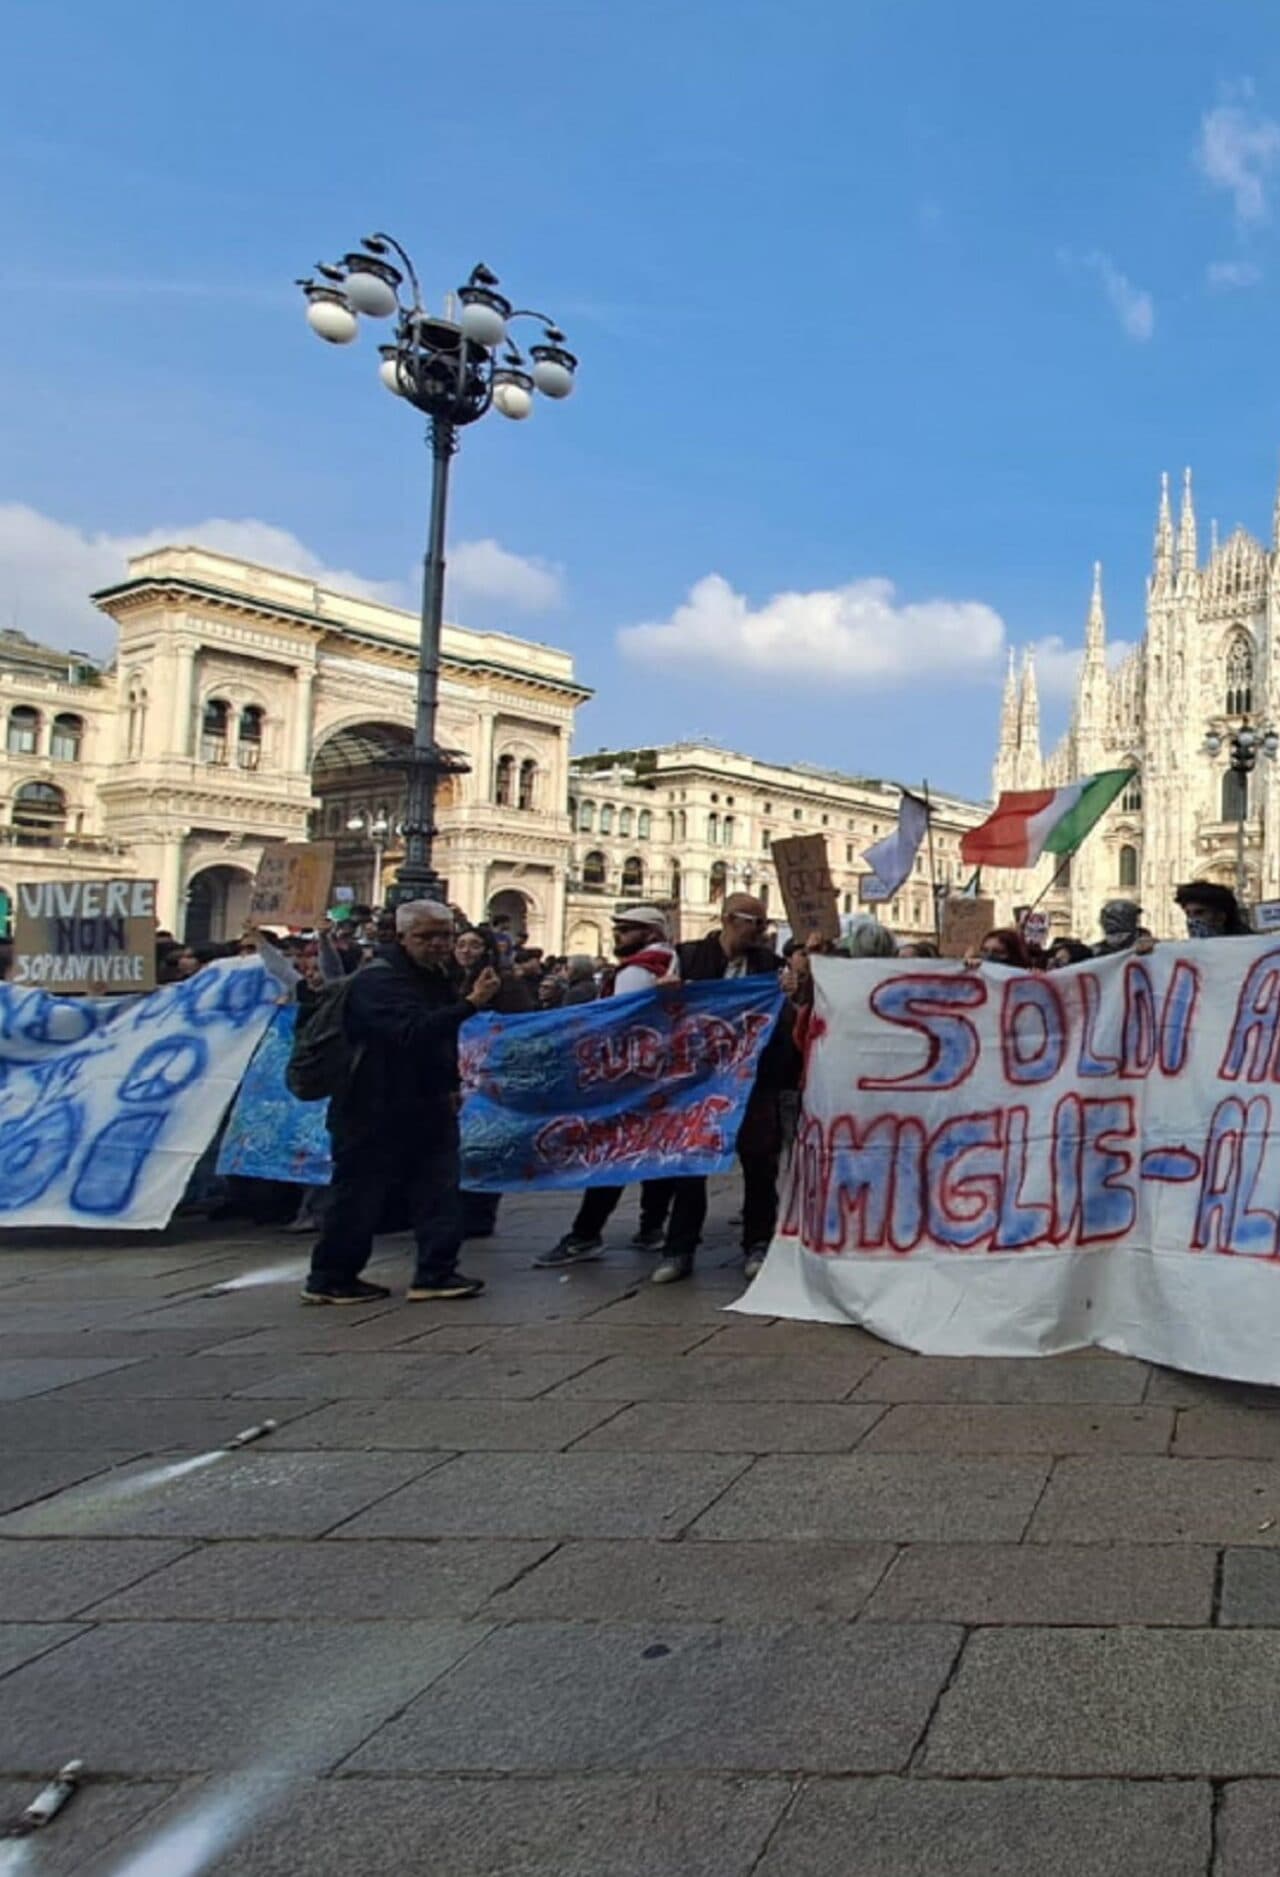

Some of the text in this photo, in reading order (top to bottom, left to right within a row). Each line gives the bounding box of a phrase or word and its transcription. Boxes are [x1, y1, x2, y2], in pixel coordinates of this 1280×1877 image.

[20, 881, 154, 918] VIVERE
[55, 917, 126, 954] NON
[857, 960, 1201, 1091] SOLDI
